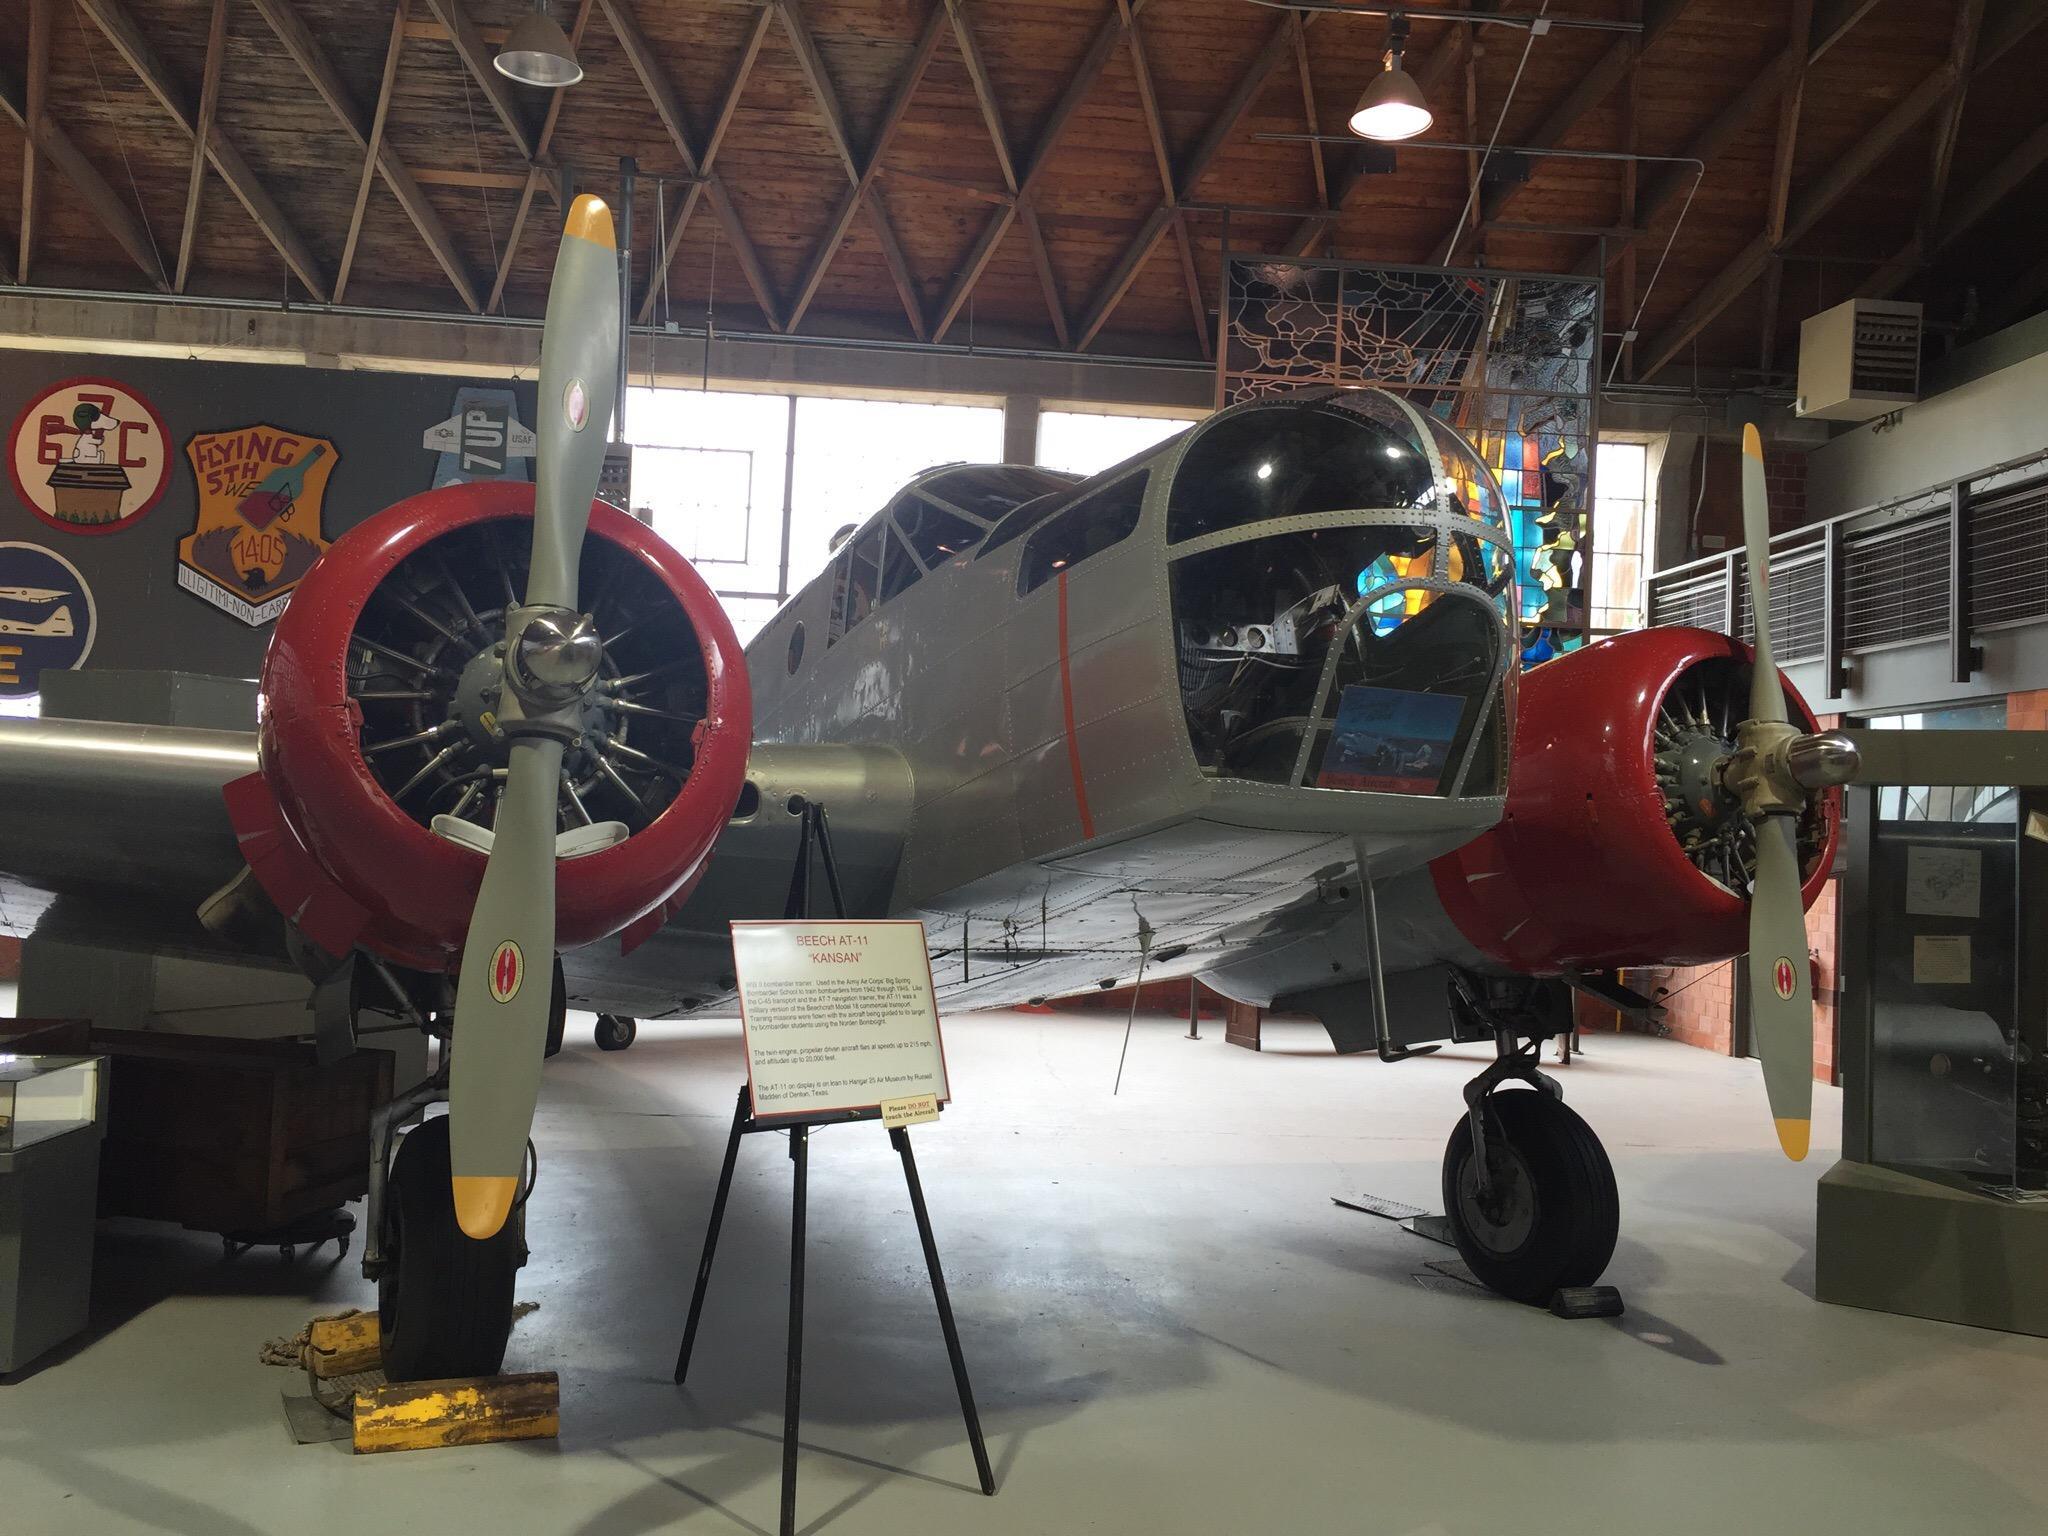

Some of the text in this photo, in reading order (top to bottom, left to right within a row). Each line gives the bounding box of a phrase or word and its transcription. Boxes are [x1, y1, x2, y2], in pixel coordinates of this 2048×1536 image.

[119, 421, 149, 468] C
[512, 434, 534, 444] USAF
[194, 432, 300, 473] FLYING
[796, 935, 868, 946] BEECH AT-11
[914, 1108, 936, 1117] Aircraft
